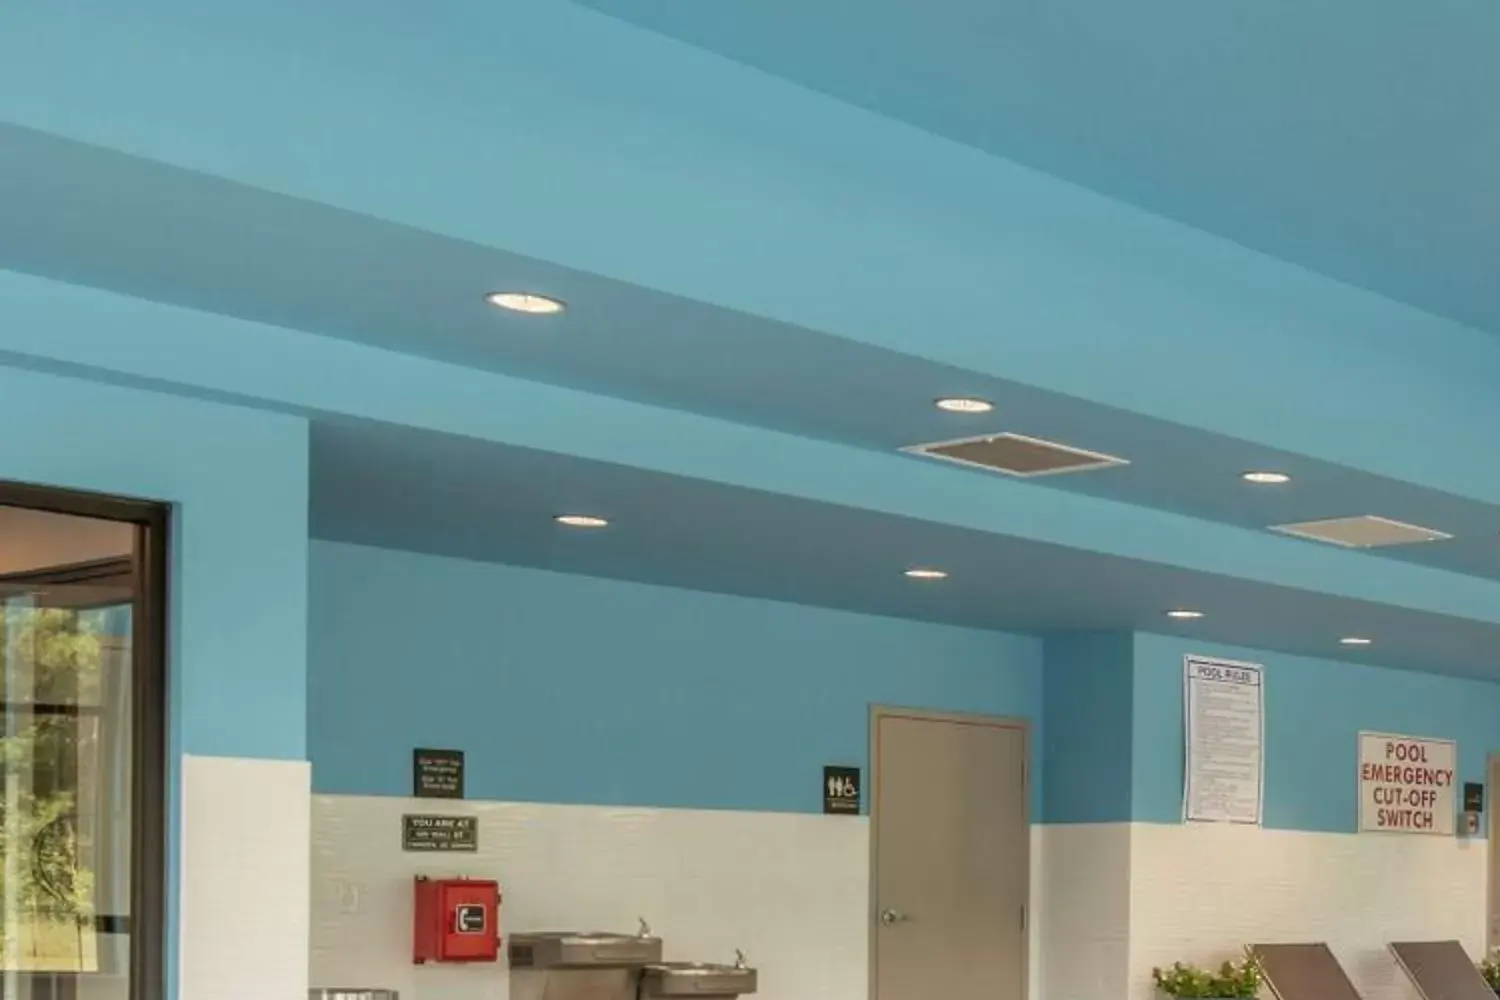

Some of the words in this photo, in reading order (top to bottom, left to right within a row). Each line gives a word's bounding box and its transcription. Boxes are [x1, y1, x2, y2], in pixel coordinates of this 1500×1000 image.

[1386, 742, 1428, 763] POOL
[1363, 763, 1453, 787] EMERGENCY
[1373, 787, 1437, 808] CUT-OFF
[413, 819, 433, 828] YOU
[1377, 808, 1433, 829] SWITCH
